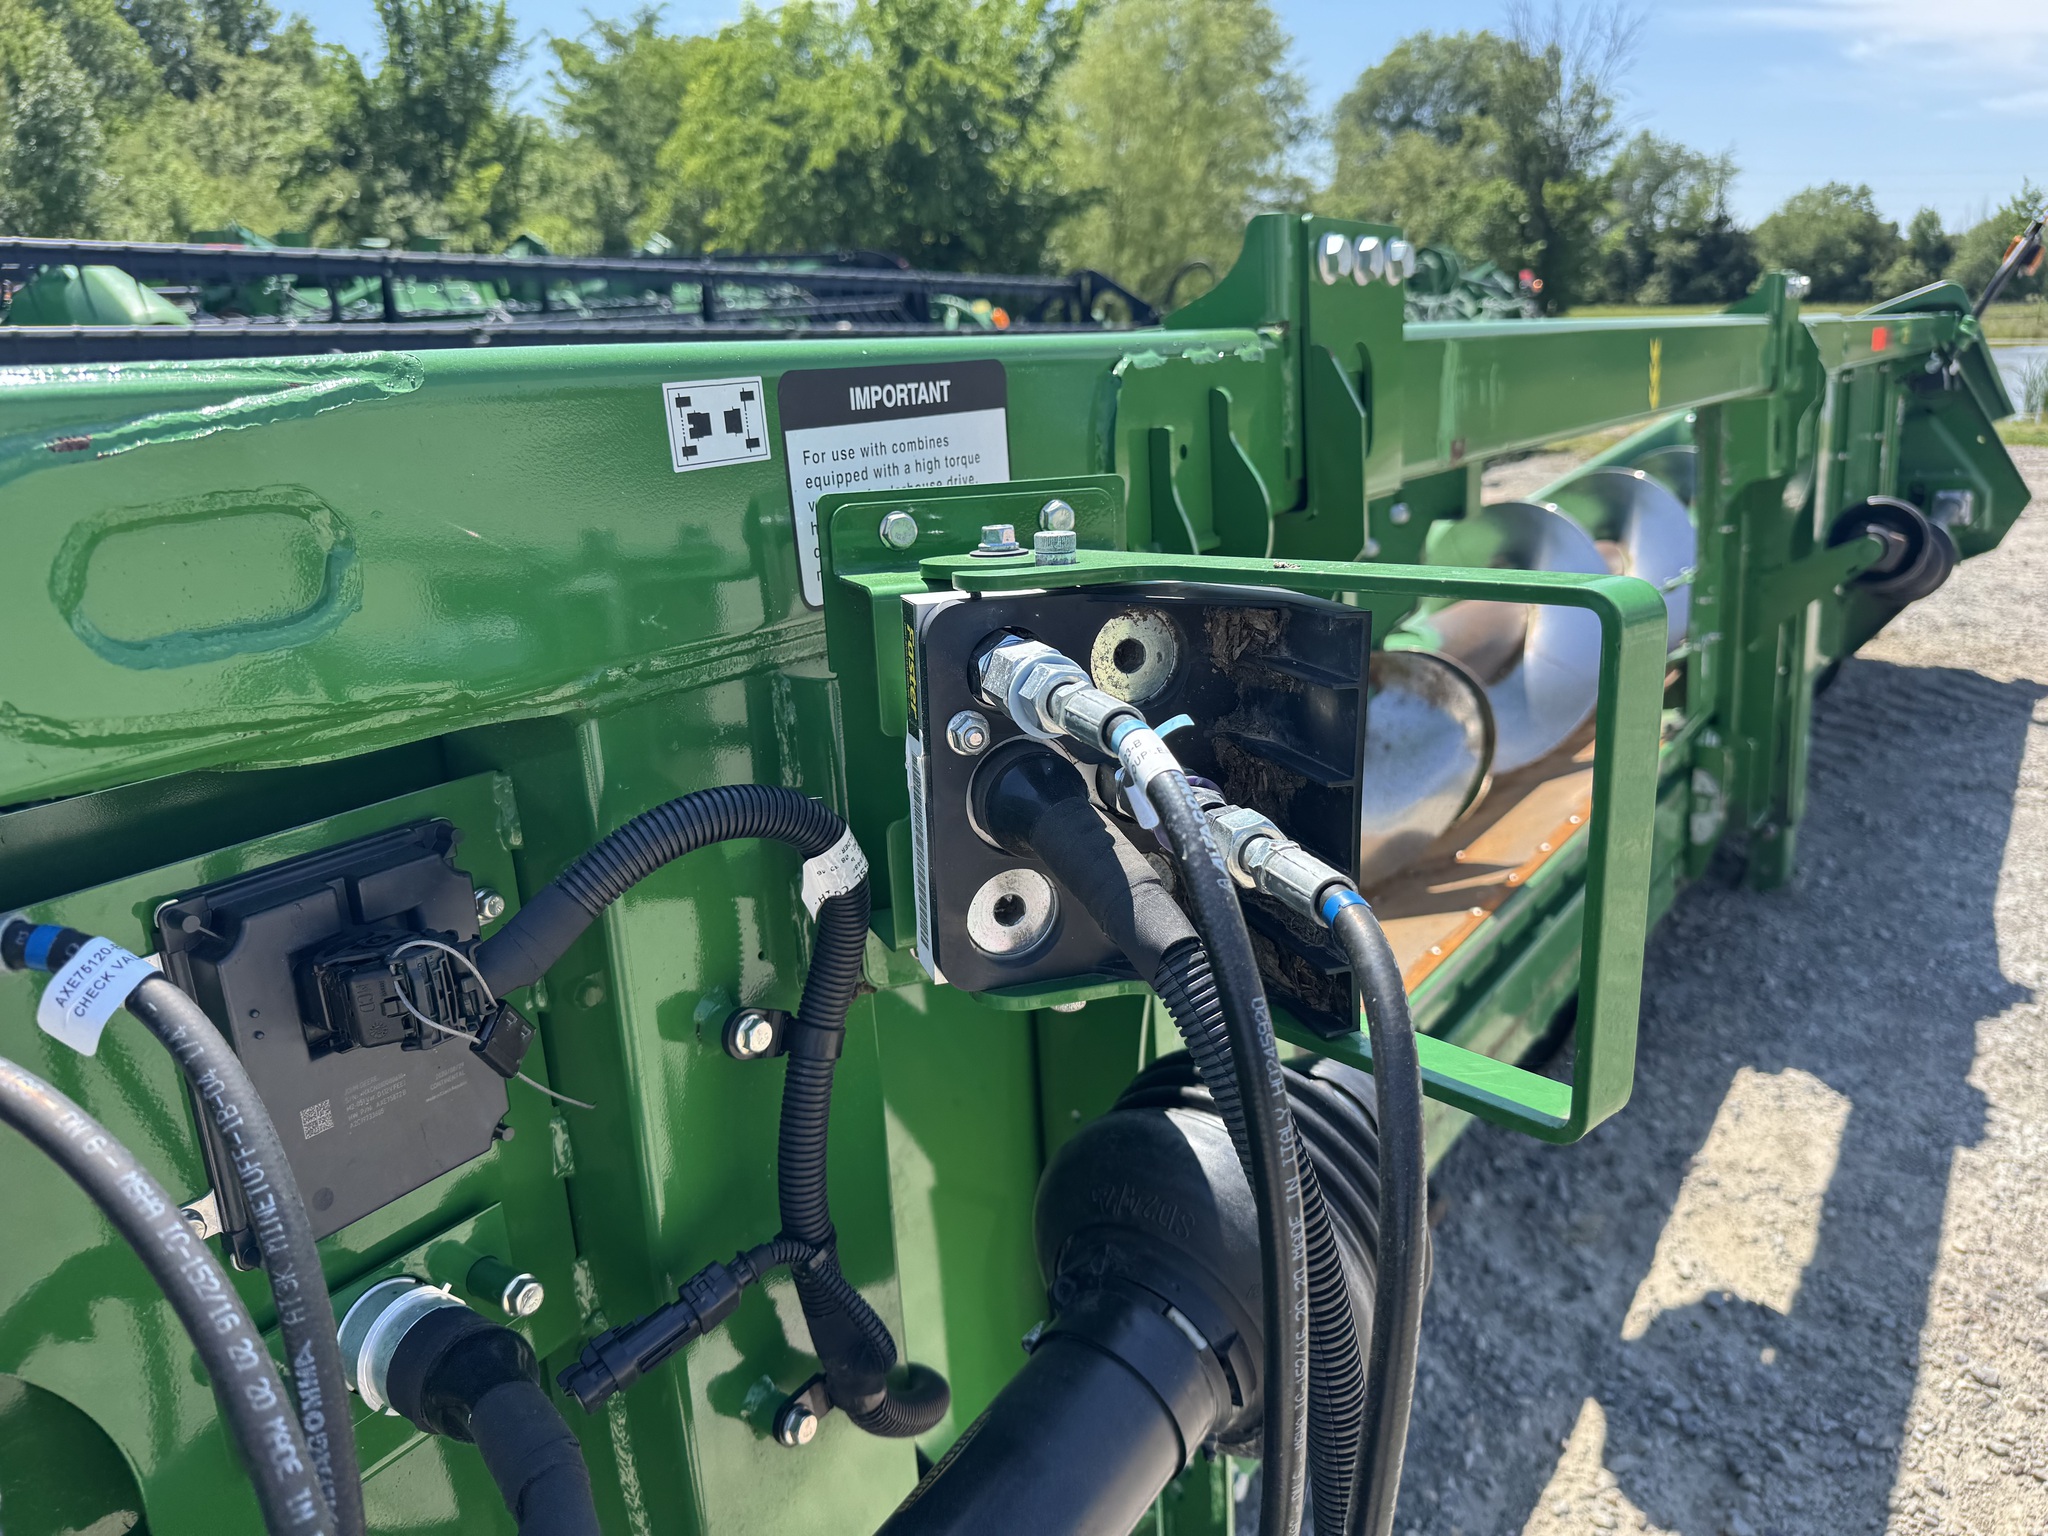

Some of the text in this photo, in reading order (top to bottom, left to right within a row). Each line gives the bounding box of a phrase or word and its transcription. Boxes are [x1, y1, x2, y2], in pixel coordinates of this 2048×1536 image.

[849, 380, 951, 411] IMPORTANT
[803, 435, 950, 466] For use with combines
[805, 466, 869, 490] equipped
[873, 462, 900, 479] with
[904, 464, 911, 475] a
[915, 457, 941, 475] high
[945, 452, 981, 470] torque
[74, 971, 115, 1018] CHECK
[1273, 1107, 1296, 1168] ITALY
[1284, 1175, 1299, 1203] IN
[227, 1337, 260, 1373] 20
[247, 1376, 279, 1412] 20
[269, 1416, 305, 1480] MADE
